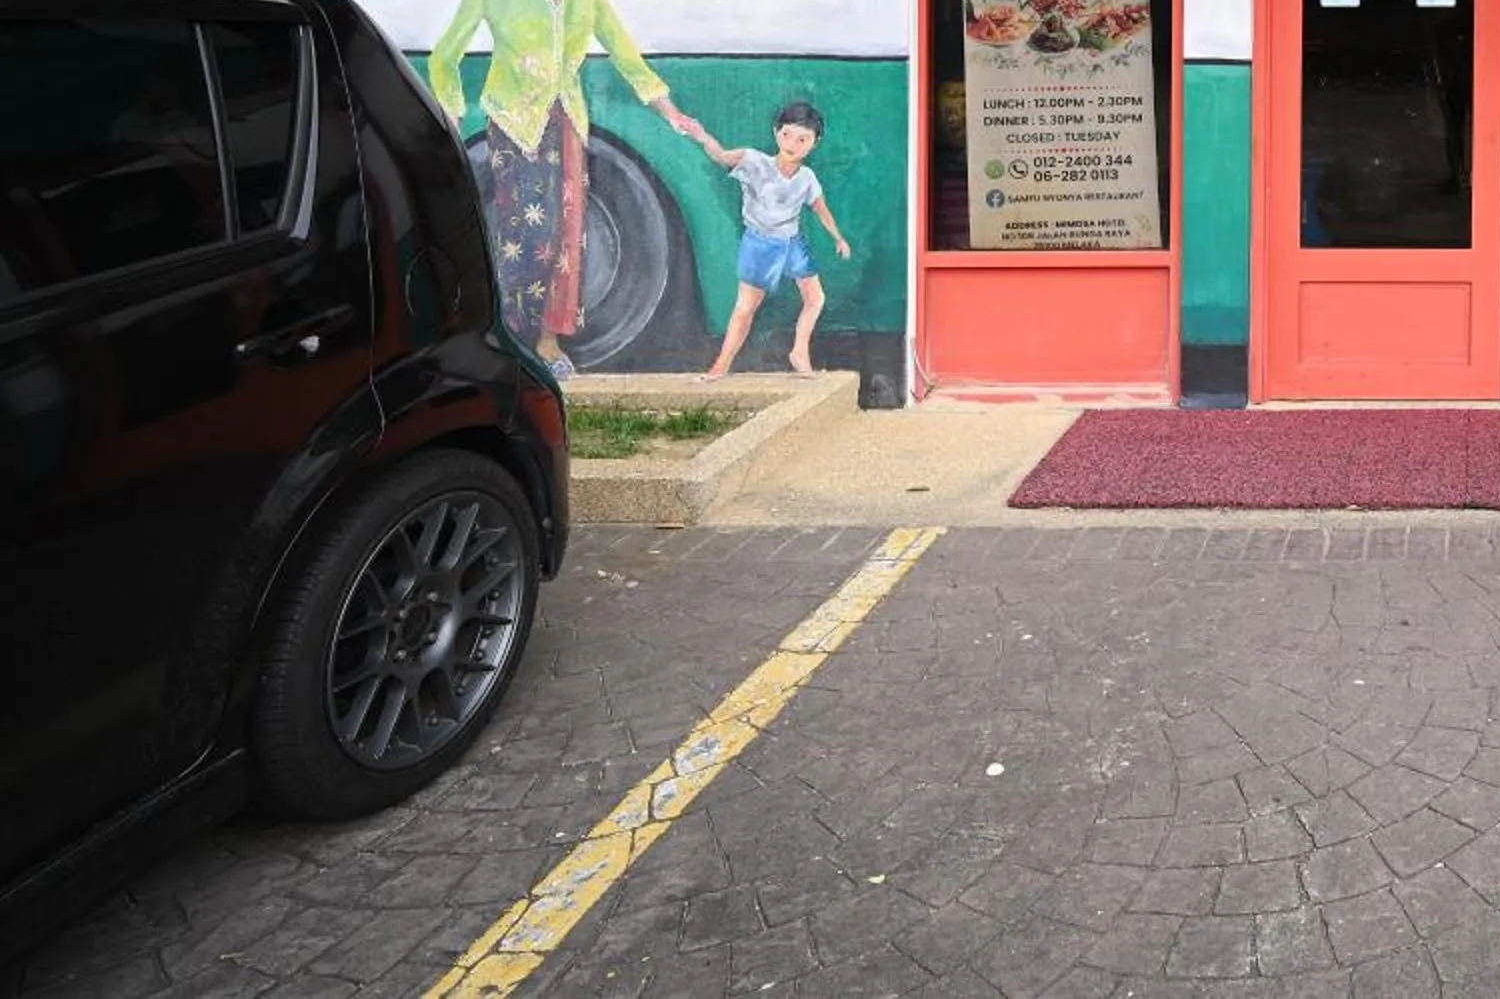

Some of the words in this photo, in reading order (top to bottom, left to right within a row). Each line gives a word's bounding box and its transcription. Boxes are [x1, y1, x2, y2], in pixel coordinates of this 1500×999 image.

[983, 99, 1025, 110] LUNCH
[983, 115, 1029, 127] DINNER
[1006, 132, 1055, 144] CLOSED
[1064, 131, 1121, 142] TUESDAY
[1033, 155, 1101, 168] 012-2400
[1105, 154, 1133, 166] 344
[1033, 170, 1087, 182] 06-282
[1091, 168, 1119, 181] 0113
